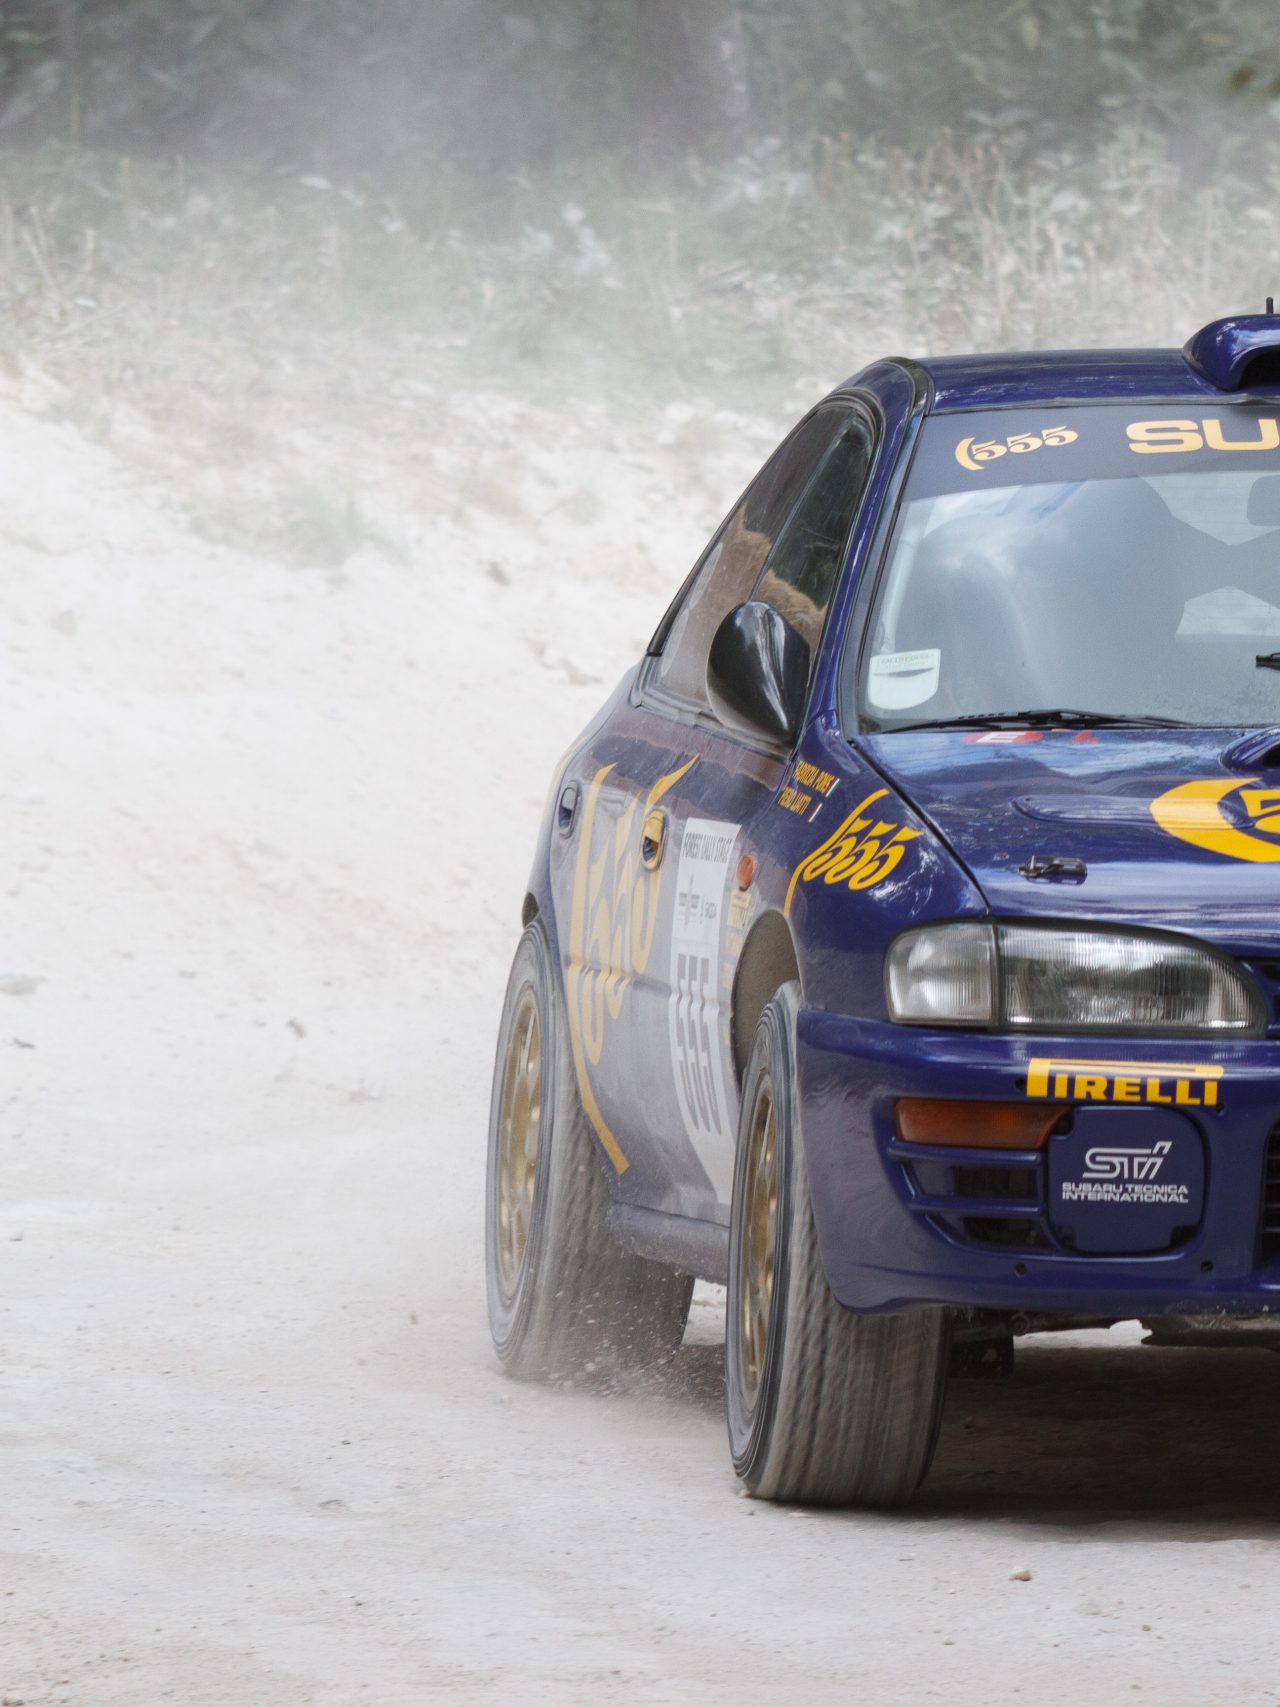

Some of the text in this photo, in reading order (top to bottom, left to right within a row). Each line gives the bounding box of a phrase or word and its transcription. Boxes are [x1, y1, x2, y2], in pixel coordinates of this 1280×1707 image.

[1026, 1057, 1225, 1107] PIRELLI
[1061, 1181, 1189, 1195] SUBARU TECNICA
[1061, 1192, 1189, 1204] INTERNATIONAL
